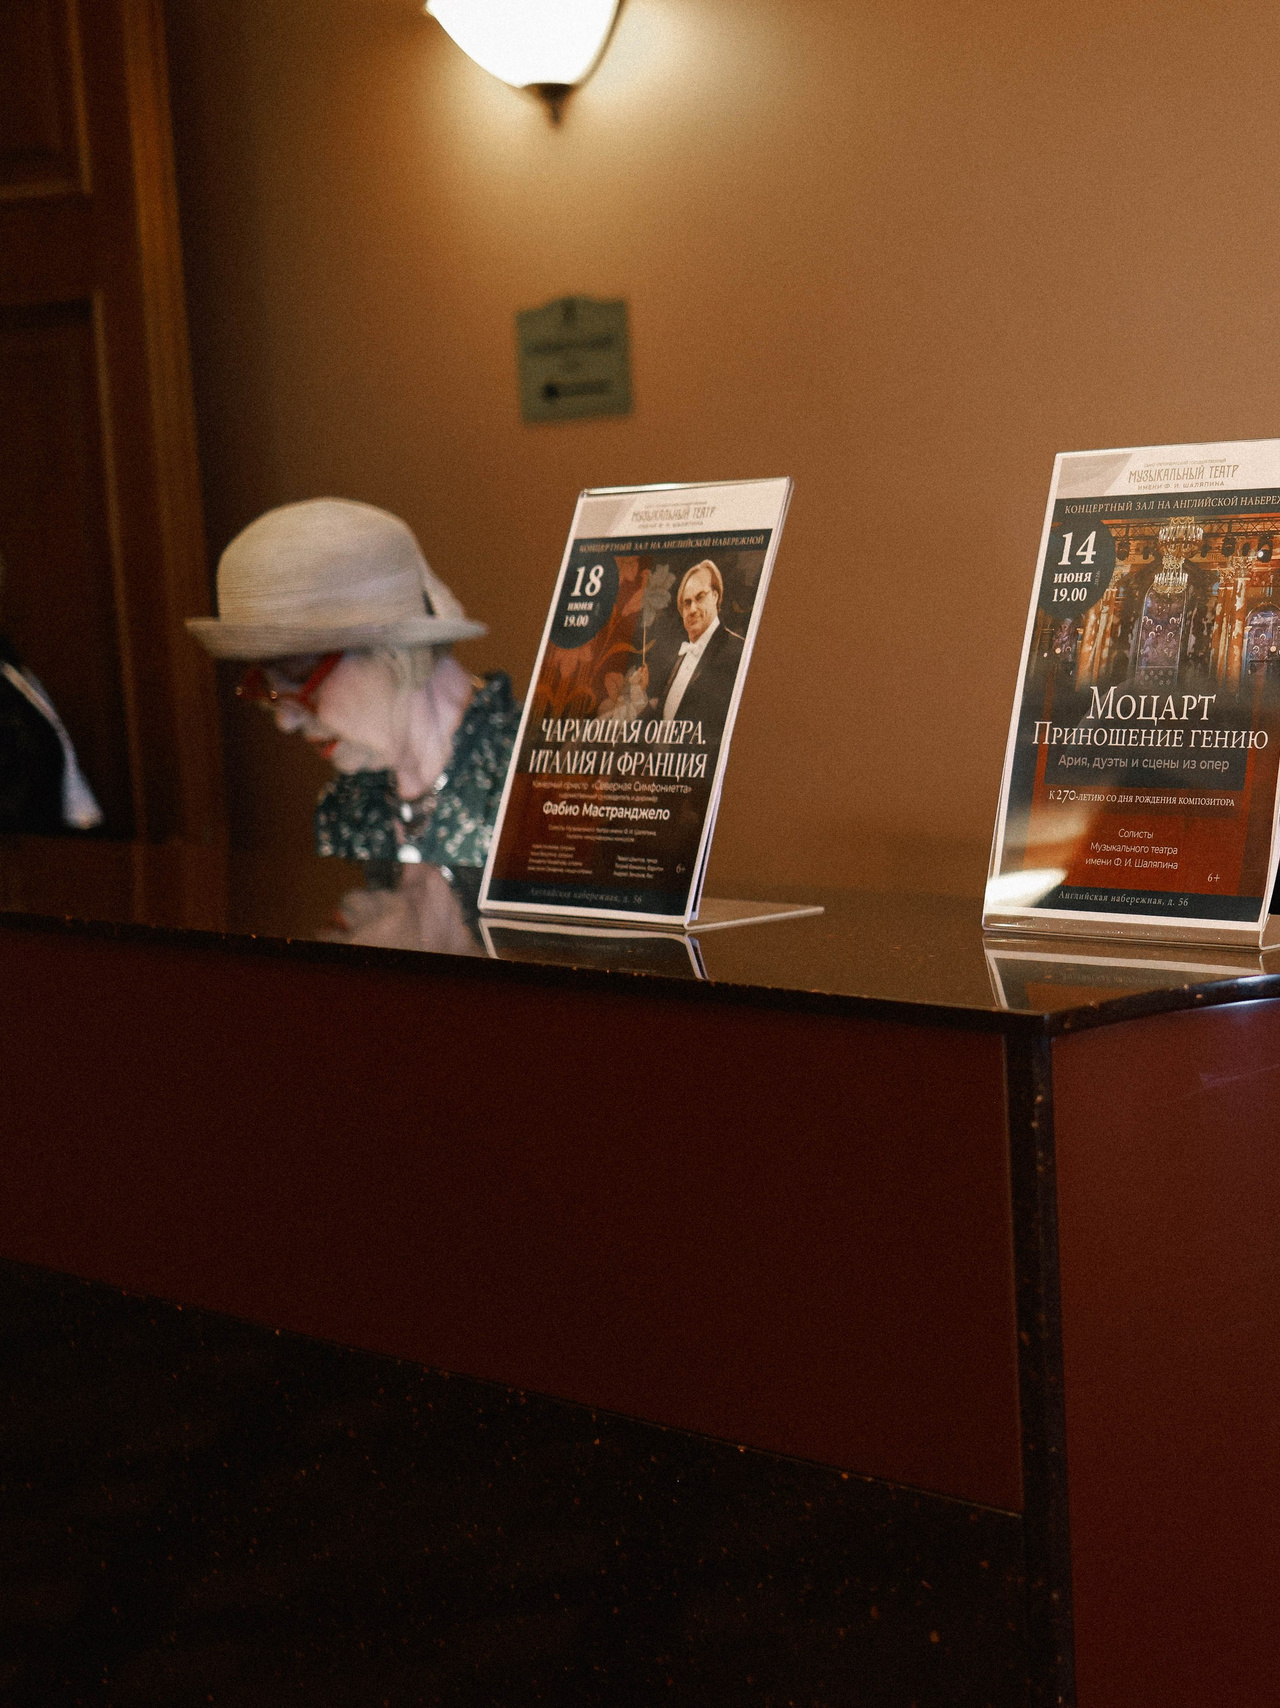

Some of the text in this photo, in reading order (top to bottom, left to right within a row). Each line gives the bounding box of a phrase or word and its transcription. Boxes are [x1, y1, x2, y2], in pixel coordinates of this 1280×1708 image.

[1128, 464, 1240, 484] МУЗЫКАЛЬНЫЙ ТЕАТР
[1137, 483, 1162, 491] ИМЕНИ
[1182, 480, 1225, 489] ШАЛЯПИНА
[1064, 500, 1133, 514] КОНЦЕРТНЫЙ
[1135, 500, 1155, 511] ЗАЛ
[1157, 500, 1171, 510] НА
[1173, 496, 1239, 509] АНГЛИЙСКОЙ
[712, 534, 765, 547] НАБЕРЕЖНОЙ
[1058, 531, 1097, 566] 14
[571, 565, 604, 597] 18
[1053, 572, 1092, 584] июня
[1052, 587, 1088, 602] 19.00
[564, 614, 590, 628] 19.00
[541, 718, 707, 746] ЧАРУЮЩАЯ ОПЕРА.
[1189, 729, 1269, 750] ГЕНИЮ
[528, 749, 709, 782] ИТАЛИЯ И ФРАНЦИЯ
[1058, 754, 1230, 773] Ария, дуэты и сцены из опер
[633, 780, 693, 795] Симфониетта»
[1048, 790, 1056, 800] К
[1105, 794, 1117, 803] СО
[1117, 795, 1134, 804] ДНЯ
[1134, 795, 1177, 805] РОЖДЕНИЯ
[1178, 797, 1235, 807] КОМПОЗИТОРА
[542, 800, 671, 821] Фабио Мастранджело
[1118, 828, 1154, 839] Солисты
[1090, 842, 1179, 856] Музыкального театра
[675, 863, 687, 874] 6+
[1085, 856, 1179, 870] имени Ф. И. Шаляпина
[1207, 872, 1221, 883] 6+
[1058, 890, 1189, 907] Английская набережная, д. 56
